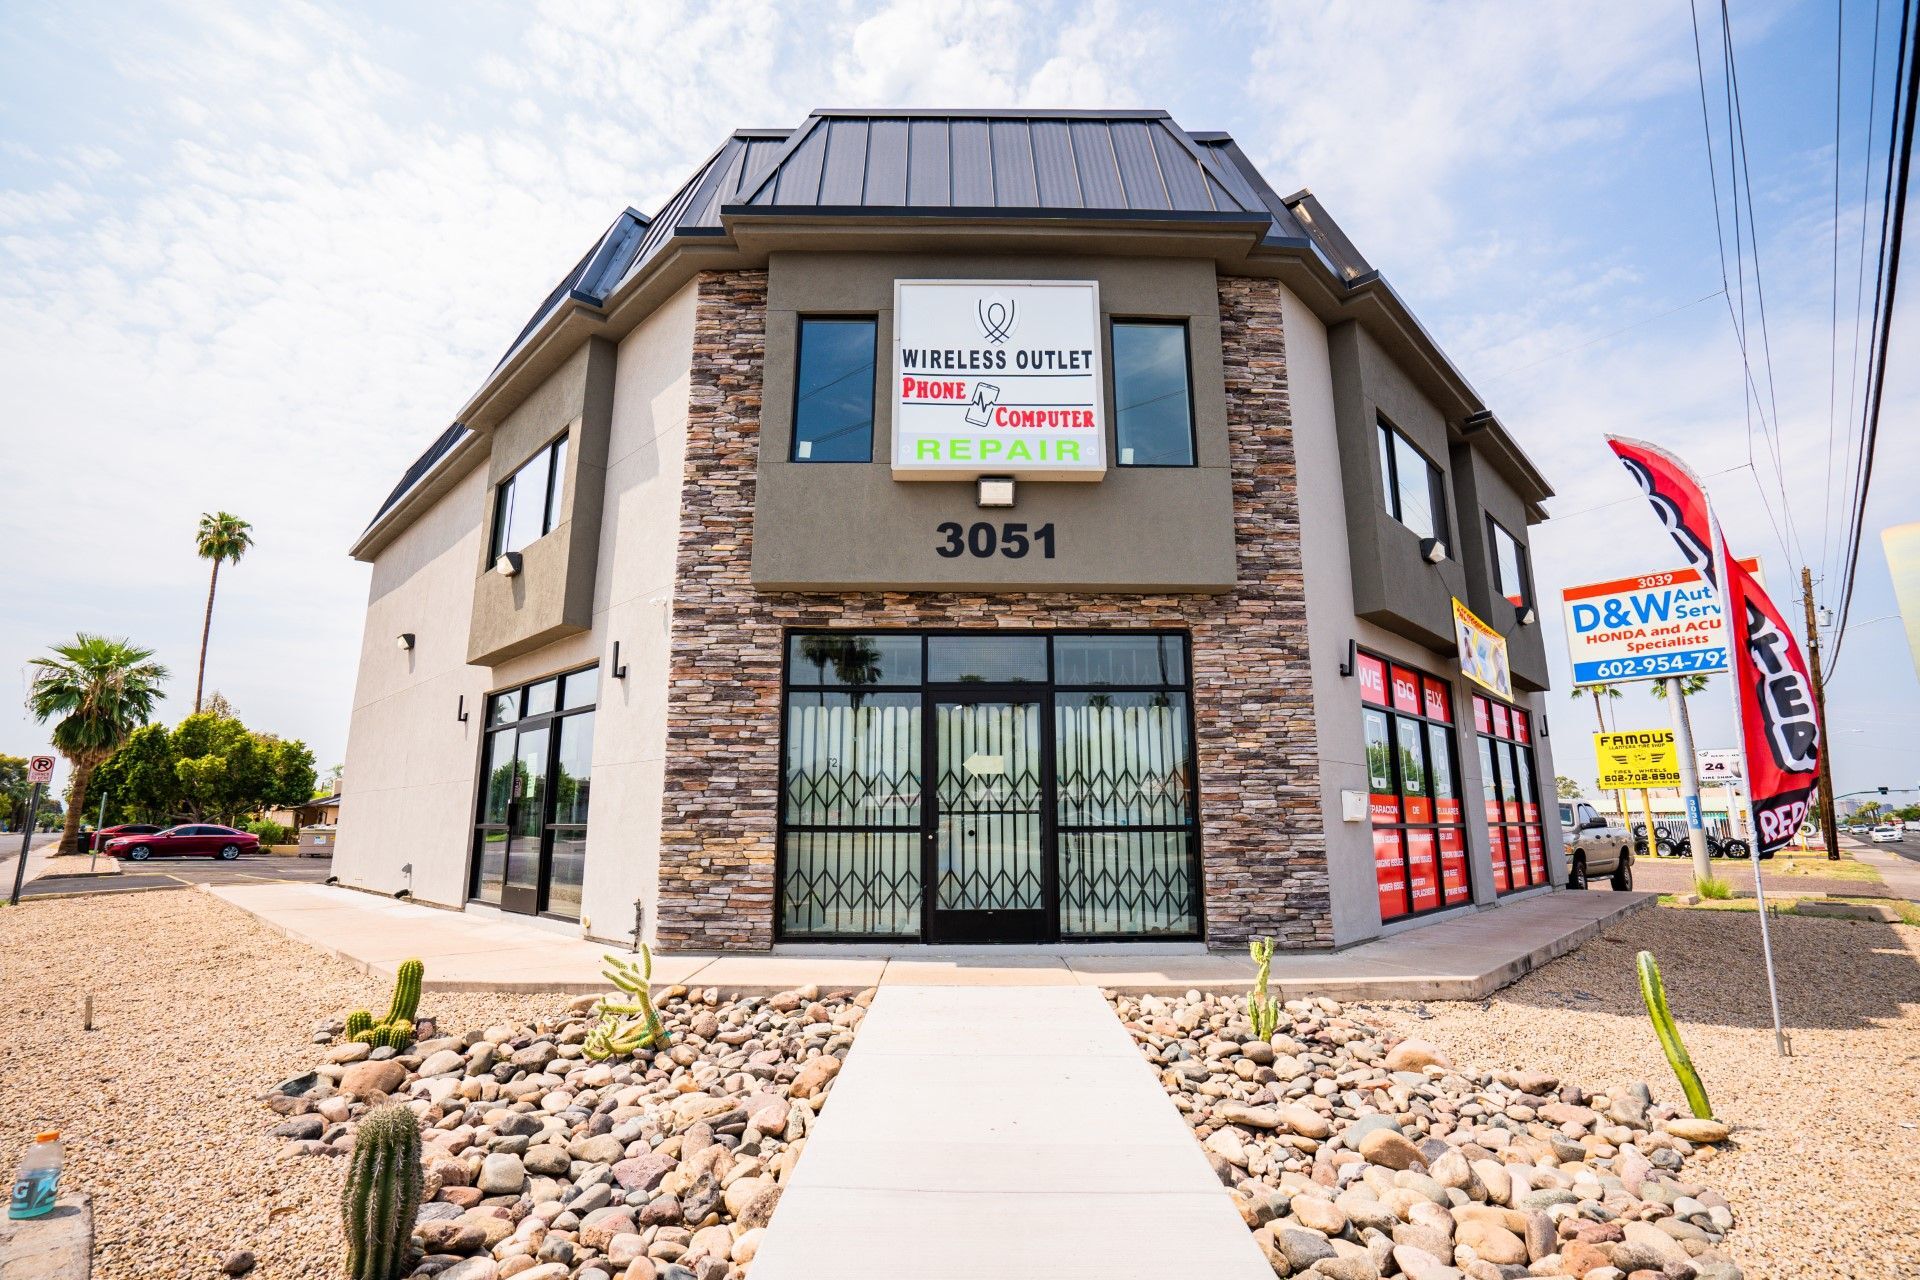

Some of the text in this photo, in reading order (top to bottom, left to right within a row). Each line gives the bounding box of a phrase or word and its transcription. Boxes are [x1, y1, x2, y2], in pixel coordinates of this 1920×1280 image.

[902, 348, 1093, 370] WIRELESS OUTLET
[902, 377, 966, 400] PHONE
[995, 407, 1095, 428] COMPUTER
[916, 439, 1080, 461] REPAIR
[935, 521, 1056, 559] 3051
[1637, 573, 1674, 588] 3039
[1572, 590, 1672, 633] D&W
[1586, 619, 1721, 645] HONDA and ACU
[1627, 634, 1709, 653] Specialists
[1358, 666, 1443, 708] WE DO FIX
[1600, 732, 1675, 746] FAMOUS
[1705, 762, 1725, 771] 24
[1412, 806, 1420, 815] DE
